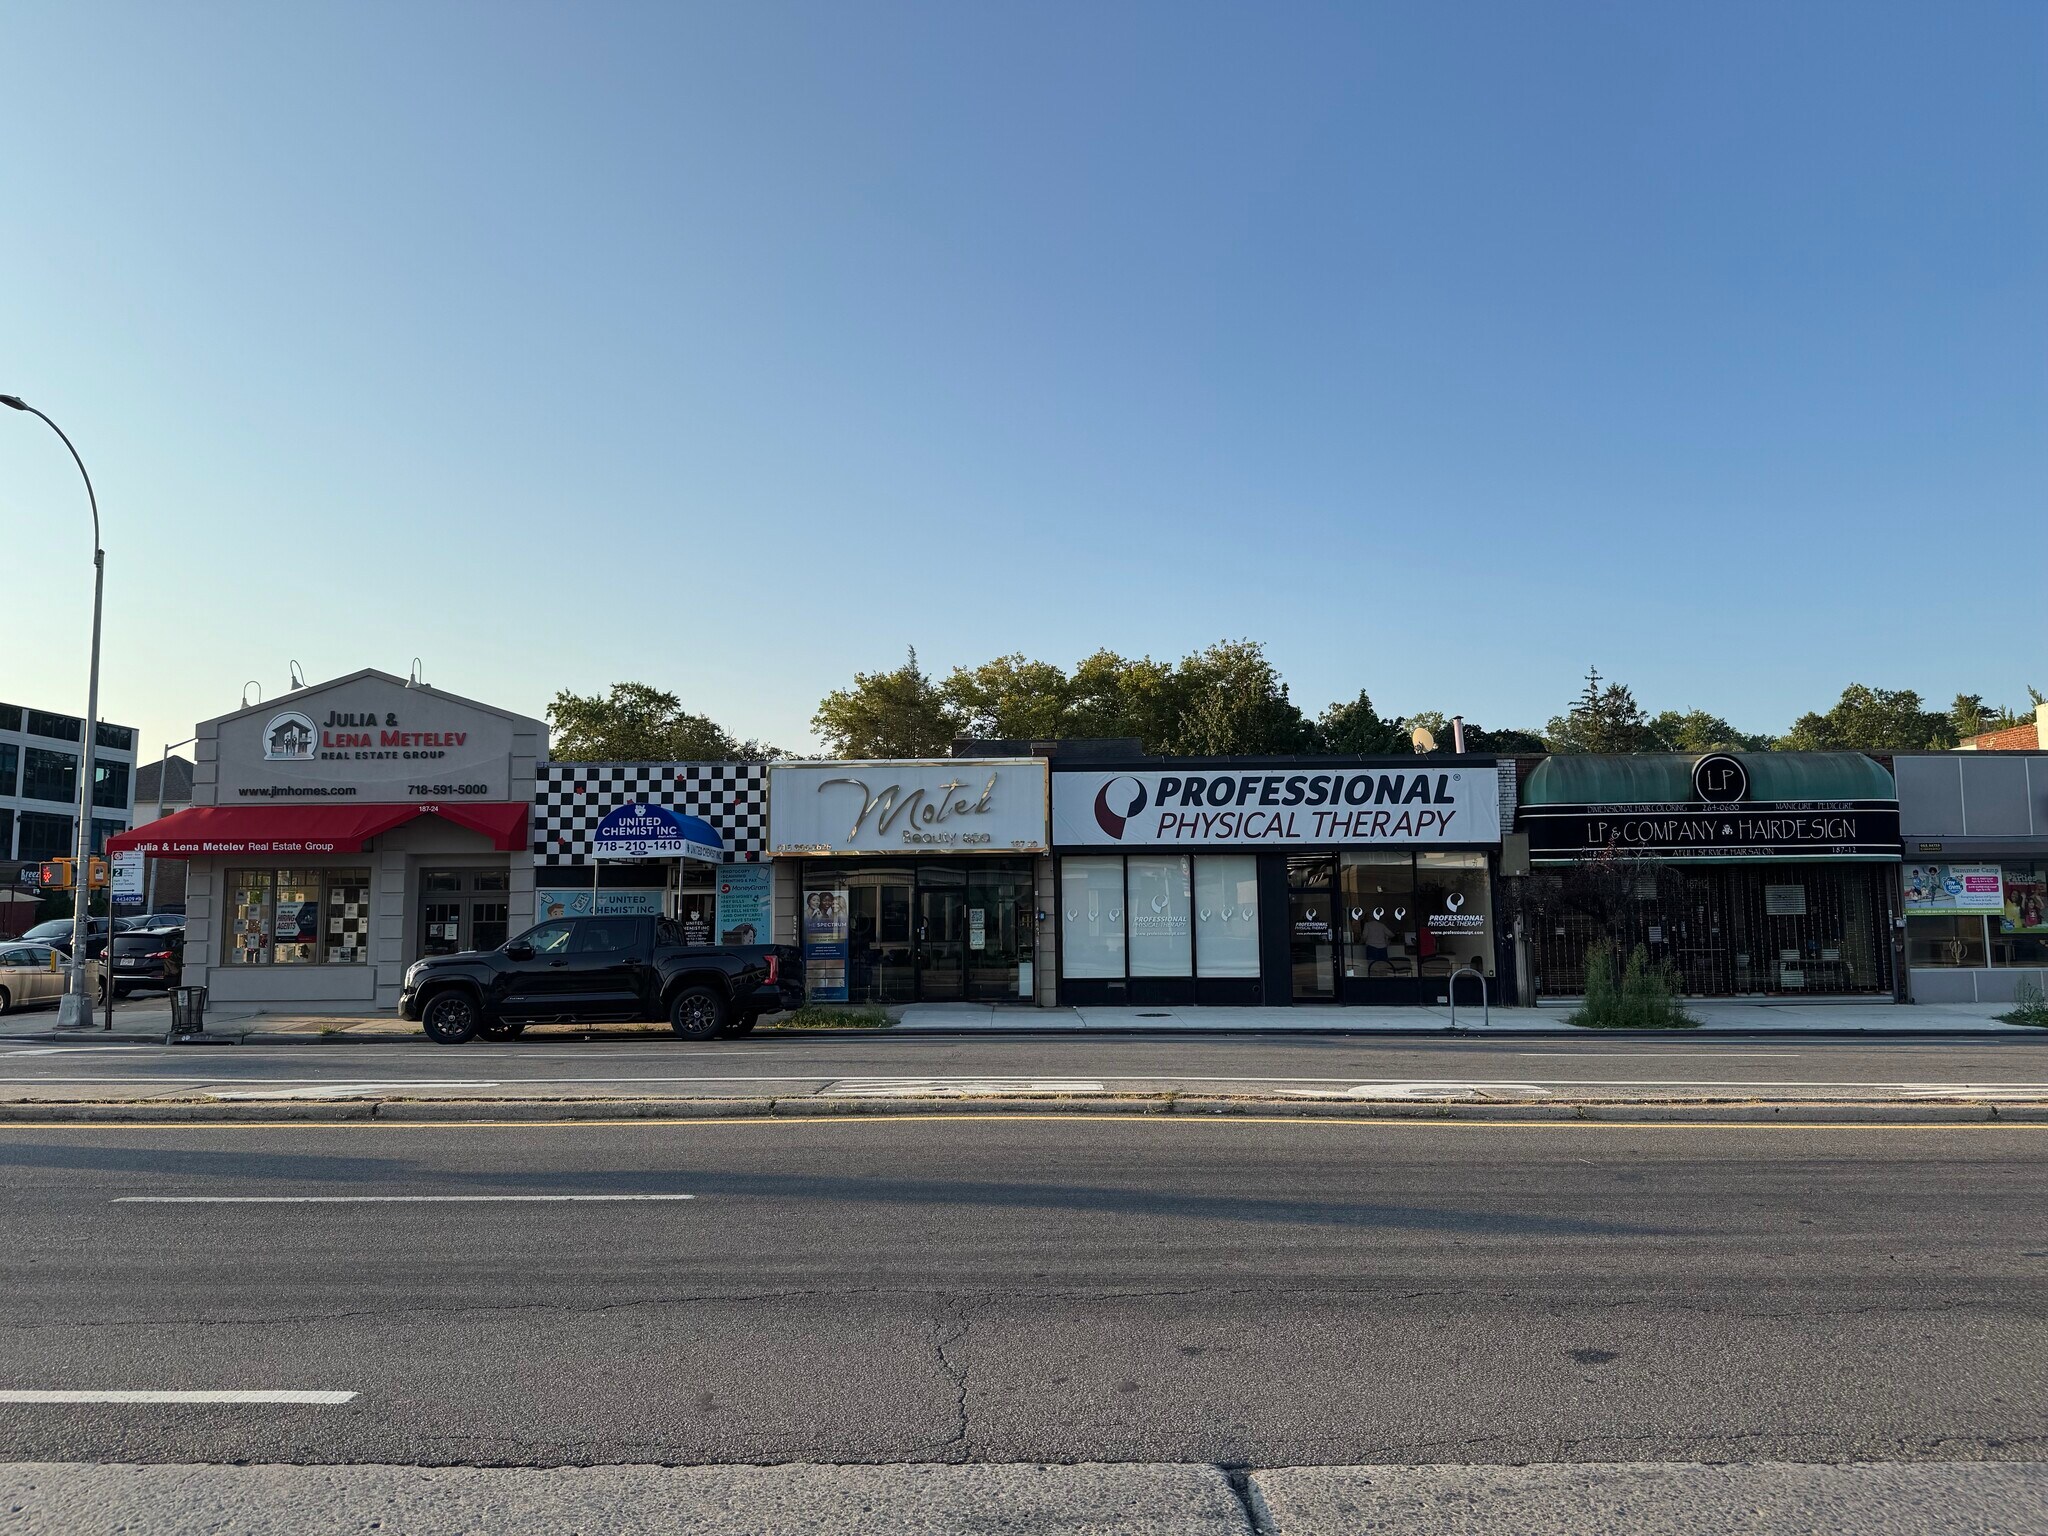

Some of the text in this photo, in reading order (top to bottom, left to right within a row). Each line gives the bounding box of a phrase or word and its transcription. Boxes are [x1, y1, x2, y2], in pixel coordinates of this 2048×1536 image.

[323, 710, 398, 728] JULIA &
[322, 730, 467, 748] LENA METELEV
[321, 750, 445, 760] REAL ESTATE GROUP
[1707, 769, 1735, 791] LP
[408, 784, 488, 795] 718-591-5000
[1155, 774, 1455, 807] PROFESSIONAL
[817, 772, 998, 843] Motek
[1702, 803, 1740, 811] 264-0600
[1817, 802, 1854, 810] PEDICURE
[618, 817, 662, 826] UNITED
[1156, 810, 1457, 839] PHYSICAL THERAPY
[602, 826, 677, 836] CHEMIST INC
[1587, 818, 1857, 842] LP & COMPANY HAIRDESIGN
[902, 830, 957, 846] Beauty
[134, 841, 334, 852] Julia & Lena Metelev Real Estate Group
[597, 840, 682, 852] 718-210-1410
[21, 868, 41, 881] Breez
[731, 884, 768, 892] MoneyGram
[609, 895, 646, 904] UNITED
[589, 906, 655, 914] CHEMIST INC
[277, 914, 296, 922] HIRING
[277, 922, 296, 930] AGENTS
